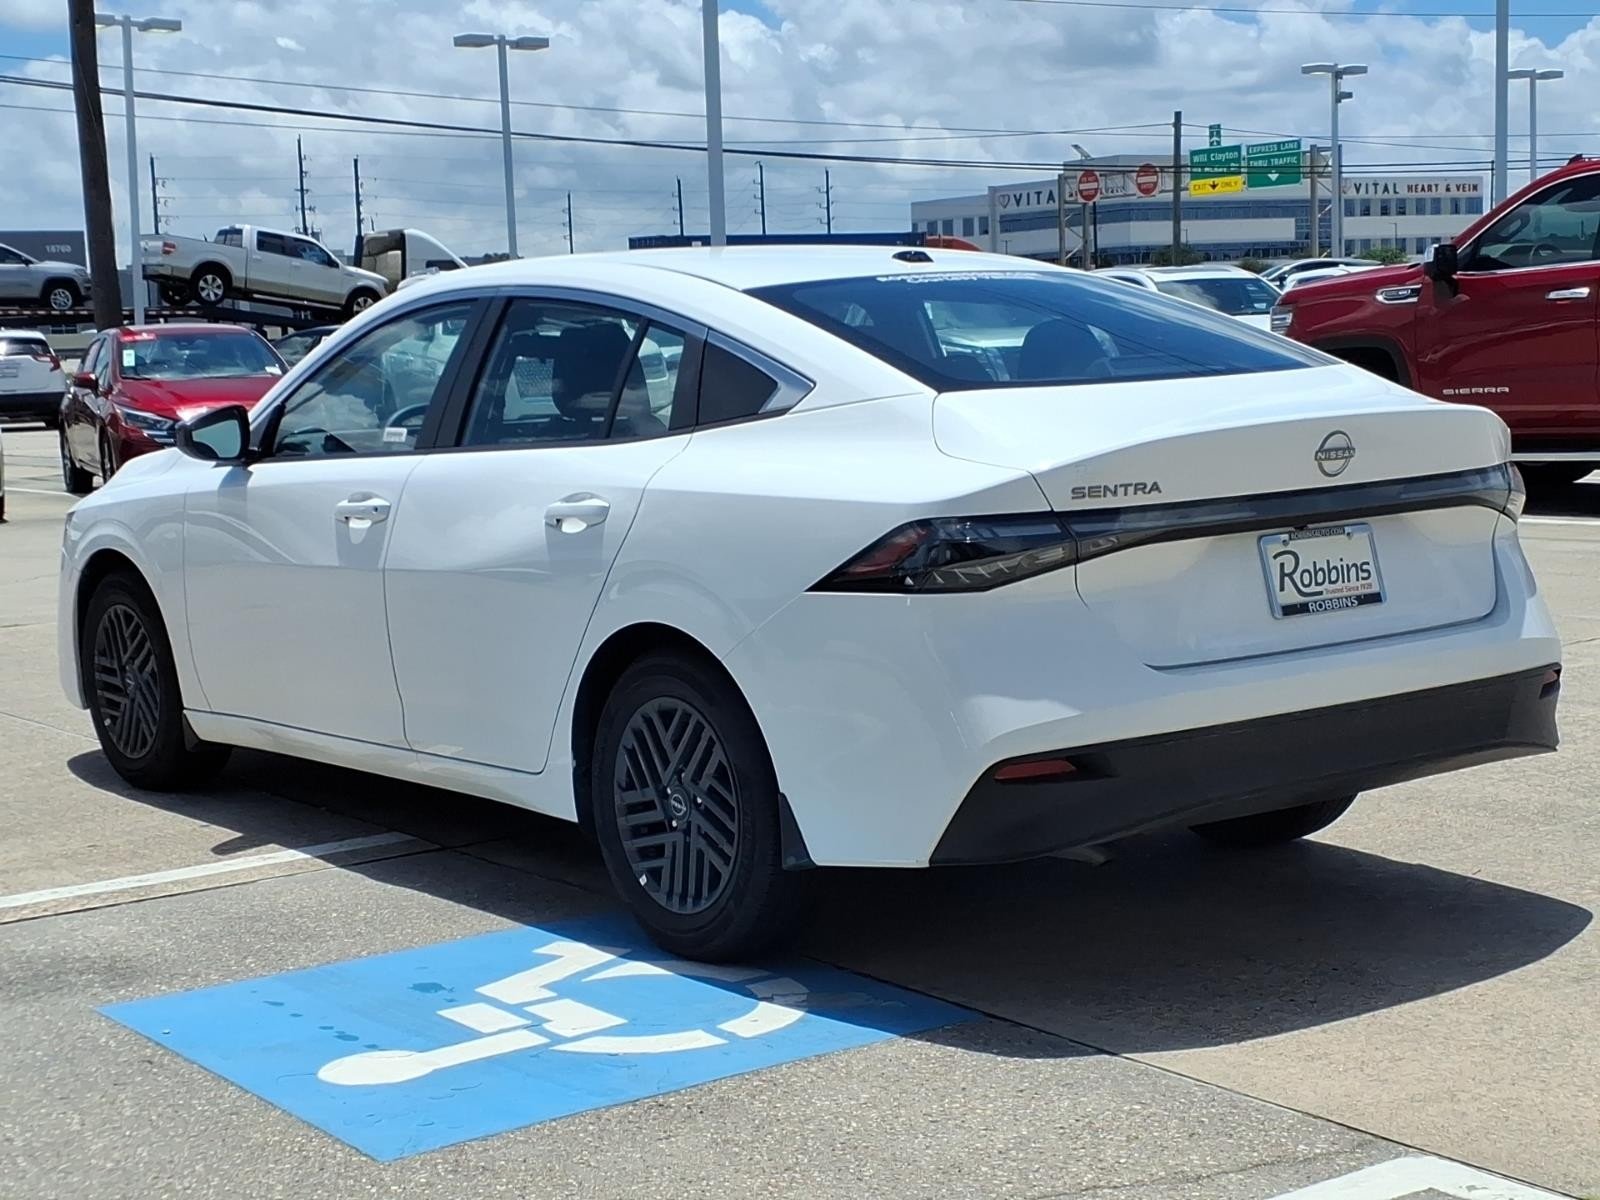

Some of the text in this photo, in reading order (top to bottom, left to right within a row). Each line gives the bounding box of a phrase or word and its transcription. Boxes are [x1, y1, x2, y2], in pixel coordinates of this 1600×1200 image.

[1248, 141, 1299, 154] EXPRESS LANE
[1192, 151, 1239, 163] Will Clayton
[1249, 156, 1298, 167] THRU TRAFFIC
[1353, 182, 1400, 195] VITAL
[1407, 183, 1440, 193] HEART
[1456, 183, 1479, 193] VEIN
[1013, 190, 1056, 207] VITA
[1442, 386, 1509, 395] SIERRA
[1316, 449, 1354, 460] NISSAN
[1071, 481, 1162, 500] SENTRA
[1272, 549, 1372, 598] Robbins
[1308, 596, 1359, 613] ROBBINS
